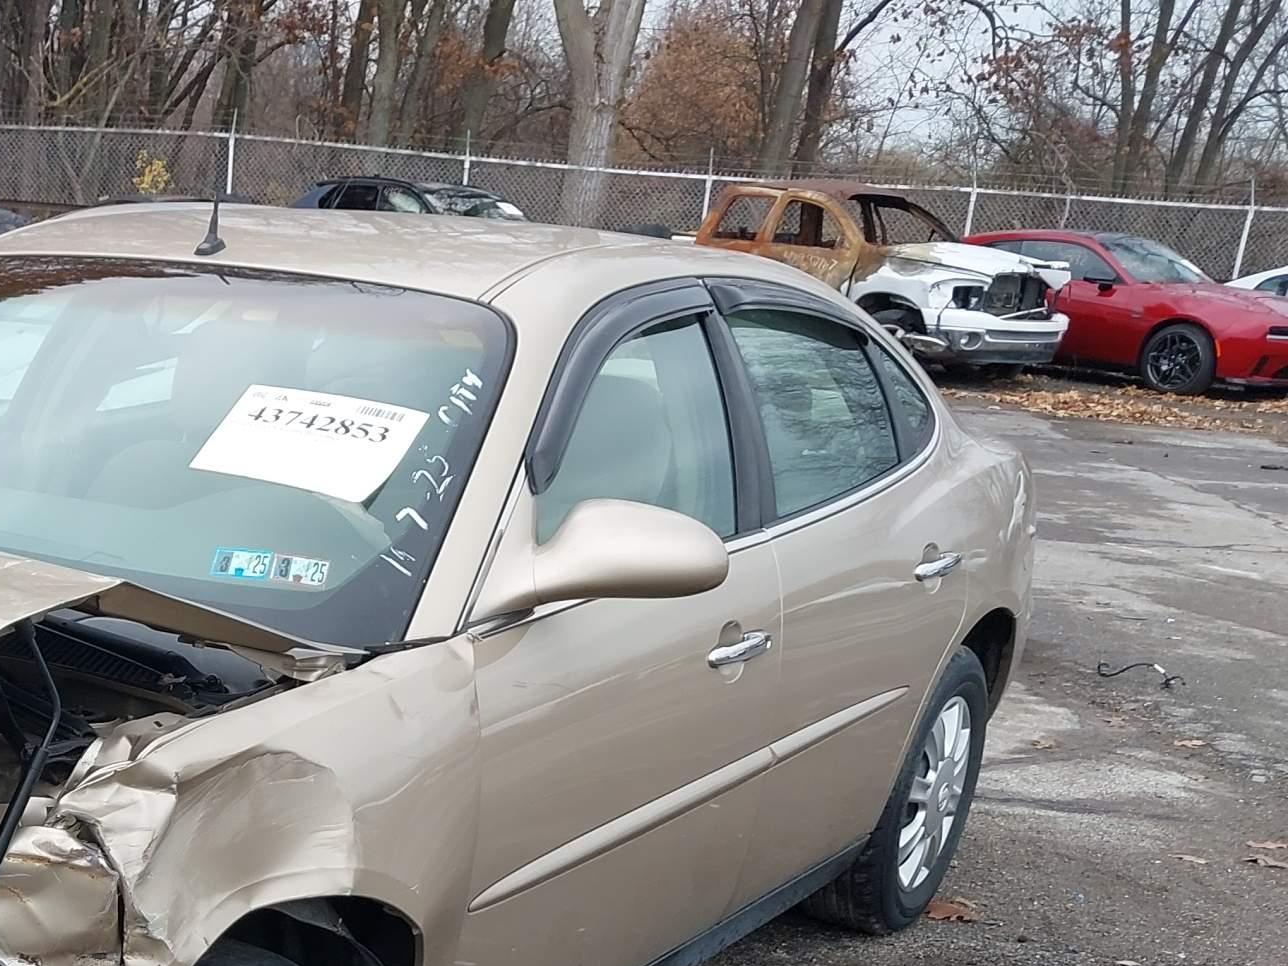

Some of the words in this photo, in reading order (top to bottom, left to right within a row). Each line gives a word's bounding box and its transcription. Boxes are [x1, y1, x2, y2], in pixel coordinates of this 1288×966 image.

[248, 405, 390, 443] 43742853
[220, 556, 230, 572] 3
[252, 554, 269, 574] 25
[279, 558, 290, 577] 3
[311, 562, 327, 583] 25
